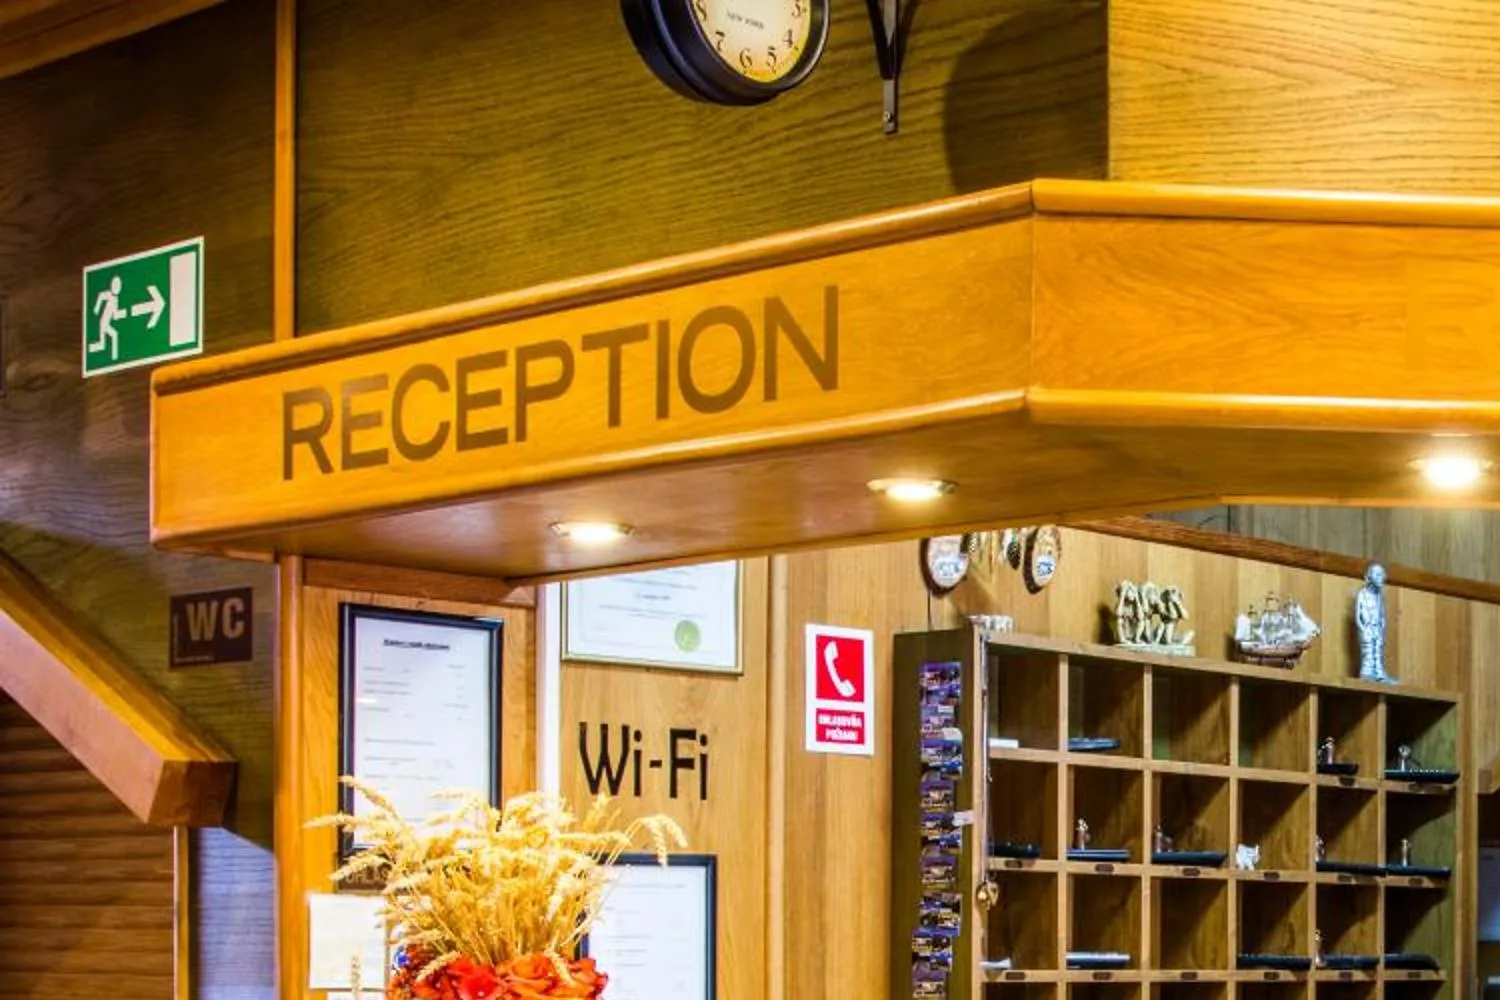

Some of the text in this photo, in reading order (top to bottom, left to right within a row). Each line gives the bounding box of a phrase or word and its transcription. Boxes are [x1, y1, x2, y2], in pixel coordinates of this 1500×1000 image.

[715, 31, 725, 52] 7
[782, 29, 794, 49] 4
[739, 48, 753, 73] 6
[766, 45, 778, 75] 5
[282, 284, 840, 482] RECEPTION
[185, 596, 246, 642] WC
[578, 721, 709, 801] Wi-Fi
